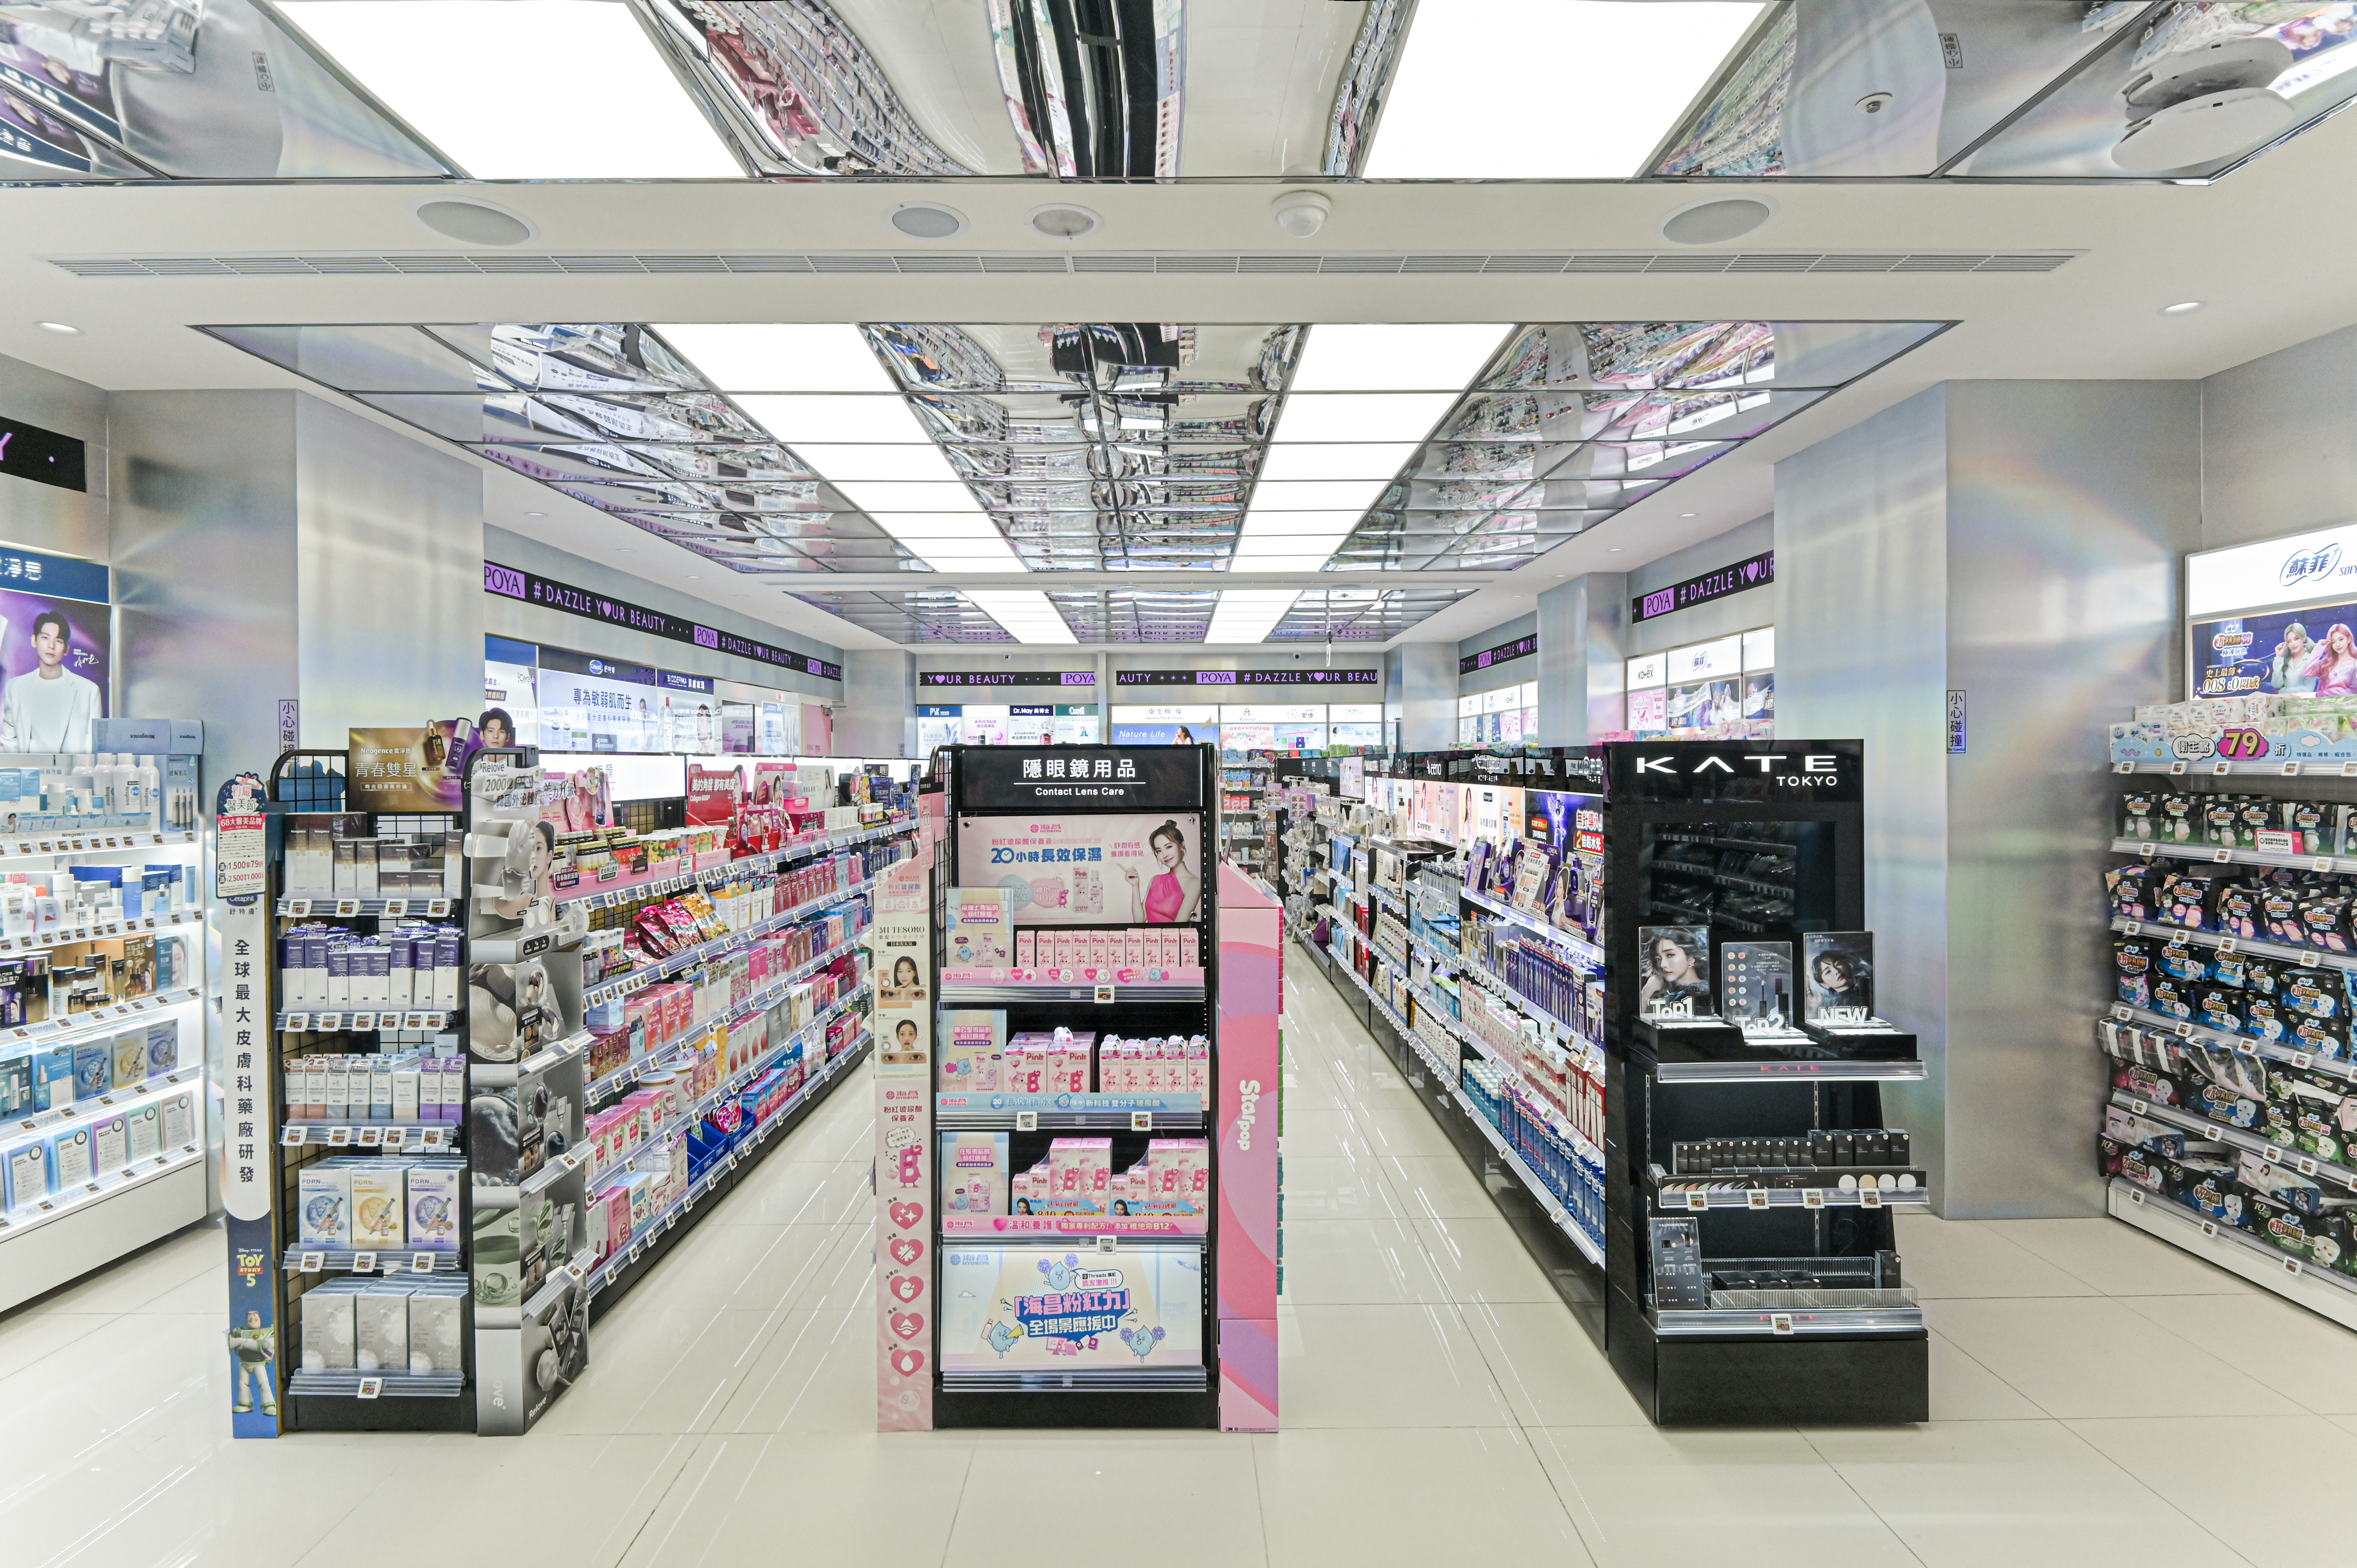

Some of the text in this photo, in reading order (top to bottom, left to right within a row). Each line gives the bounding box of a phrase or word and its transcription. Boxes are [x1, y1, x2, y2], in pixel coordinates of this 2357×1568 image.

[2286, 554, 2330, 578] 蘇菲
[484, 566, 520, 595] POYA
[1647, 592, 1671, 614] POYA
[1691, 571, 1733, 600] DAZZLE
[546, 585, 591, 613] DAZZLE
[631, 609, 665, 632] BEAUTY
[697, 628, 716, 646] POYA
[728, 637, 751, 655] DAZZLE
[772, 650, 792, 666] BEAUTY
[2214, 633, 2252, 649] 超熟睡褲
[1479, 654, 1490, 666] POYA
[1497, 645, 1514, 660] DAZZLE
[809, 660, 821, 675] POYA
[2206, 667, 2236, 678] 史上最薄
[969, 675, 1016, 683] BEAUTY
[1066, 674, 1095, 683] POYA
[1119, 673, 1151, 682] AUTY
[1201, 673, 1232, 682] POYA
[1256, 673, 1301, 682] DAZZLE
[2202, 677, 2226, 693] 008
[574, 687, 632, 710] 專為敏弱肌而生
[930, 707, 940, 716] PSK
[1950, 692, 1963, 747] 小心碰撞
[1118, 729, 1147, 738] Nature
[2177, 731, 2286, 756] 衛生棉 79 折
[355, 762, 417, 777] 青春雙星
[482, 762, 505, 773] Relove
[1023, 758, 1136, 778] 隱眼鏡用品
[1636, 755, 1837, 773] KATE
[692, 778, 736, 792] 美的角度 都有美度
[1776, 775, 1838, 787] TOKYO
[232, 785, 252, 797] 粉耀
[1035, 787, 1072, 796] Contact
[1101, 787, 1124, 796] Care
[227, 798, 256, 811] 醫美節
[690, 795, 701, 803] Collagen
[221, 817, 262, 826] 68大醫美品牌
[991, 847, 1102, 864] 20小時長效保濕
[2164, 948, 2188, 959] 超熟睡
[2217, 952, 2244, 964] 超熟睡
[2118, 954, 2148, 969] 超熟睡
[2293, 987, 2320, 999] 超熟睡
[1649, 996, 1694, 1019] Top1
[1820, 1007, 1868, 1026] NEW
[1735, 1013, 1785, 1036] Top2
[2299, 1028, 2324, 1040] 超熟睡
[235, 939, 254, 1183] 全球最大皮膚科藥廠研發
[1026, 1052, 1044, 1061] Pink
[1069, 1052, 1087, 1061] Pink
[2131, 1069, 2156, 1084] 超熟睡
[1006, 1096, 1051, 1107] 長效鎖水
[1086, 1099, 1110, 1107] 新科技
[2206, 1088, 2235, 1104] 超熟睡
[1237, 1079, 1261, 1151] Starpop
[2102, 1140, 2113, 1148] 10
[716, 1145, 724, 1157] DHC
[704, 1157, 713, 1169] DHC
[689, 1169, 699, 1182] DHC
[2255, 1202, 2266, 1212] 10
[1009, 1220, 1052, 1230] 溫和養護
[1130, 1222, 1170, 1230] 維他命B12
[2271, 1224, 2303, 1240] 超熟睡
[2302, 1236, 2316, 1245] 350
[237, 1254, 264, 1267] TOY
[246, 1273, 256, 1287] 5
[1082, 1279, 1109, 1287] 脆友激推
[1029, 1314, 1116, 1336] 全場景應援中
[529, 1396, 547, 1420] Relove
